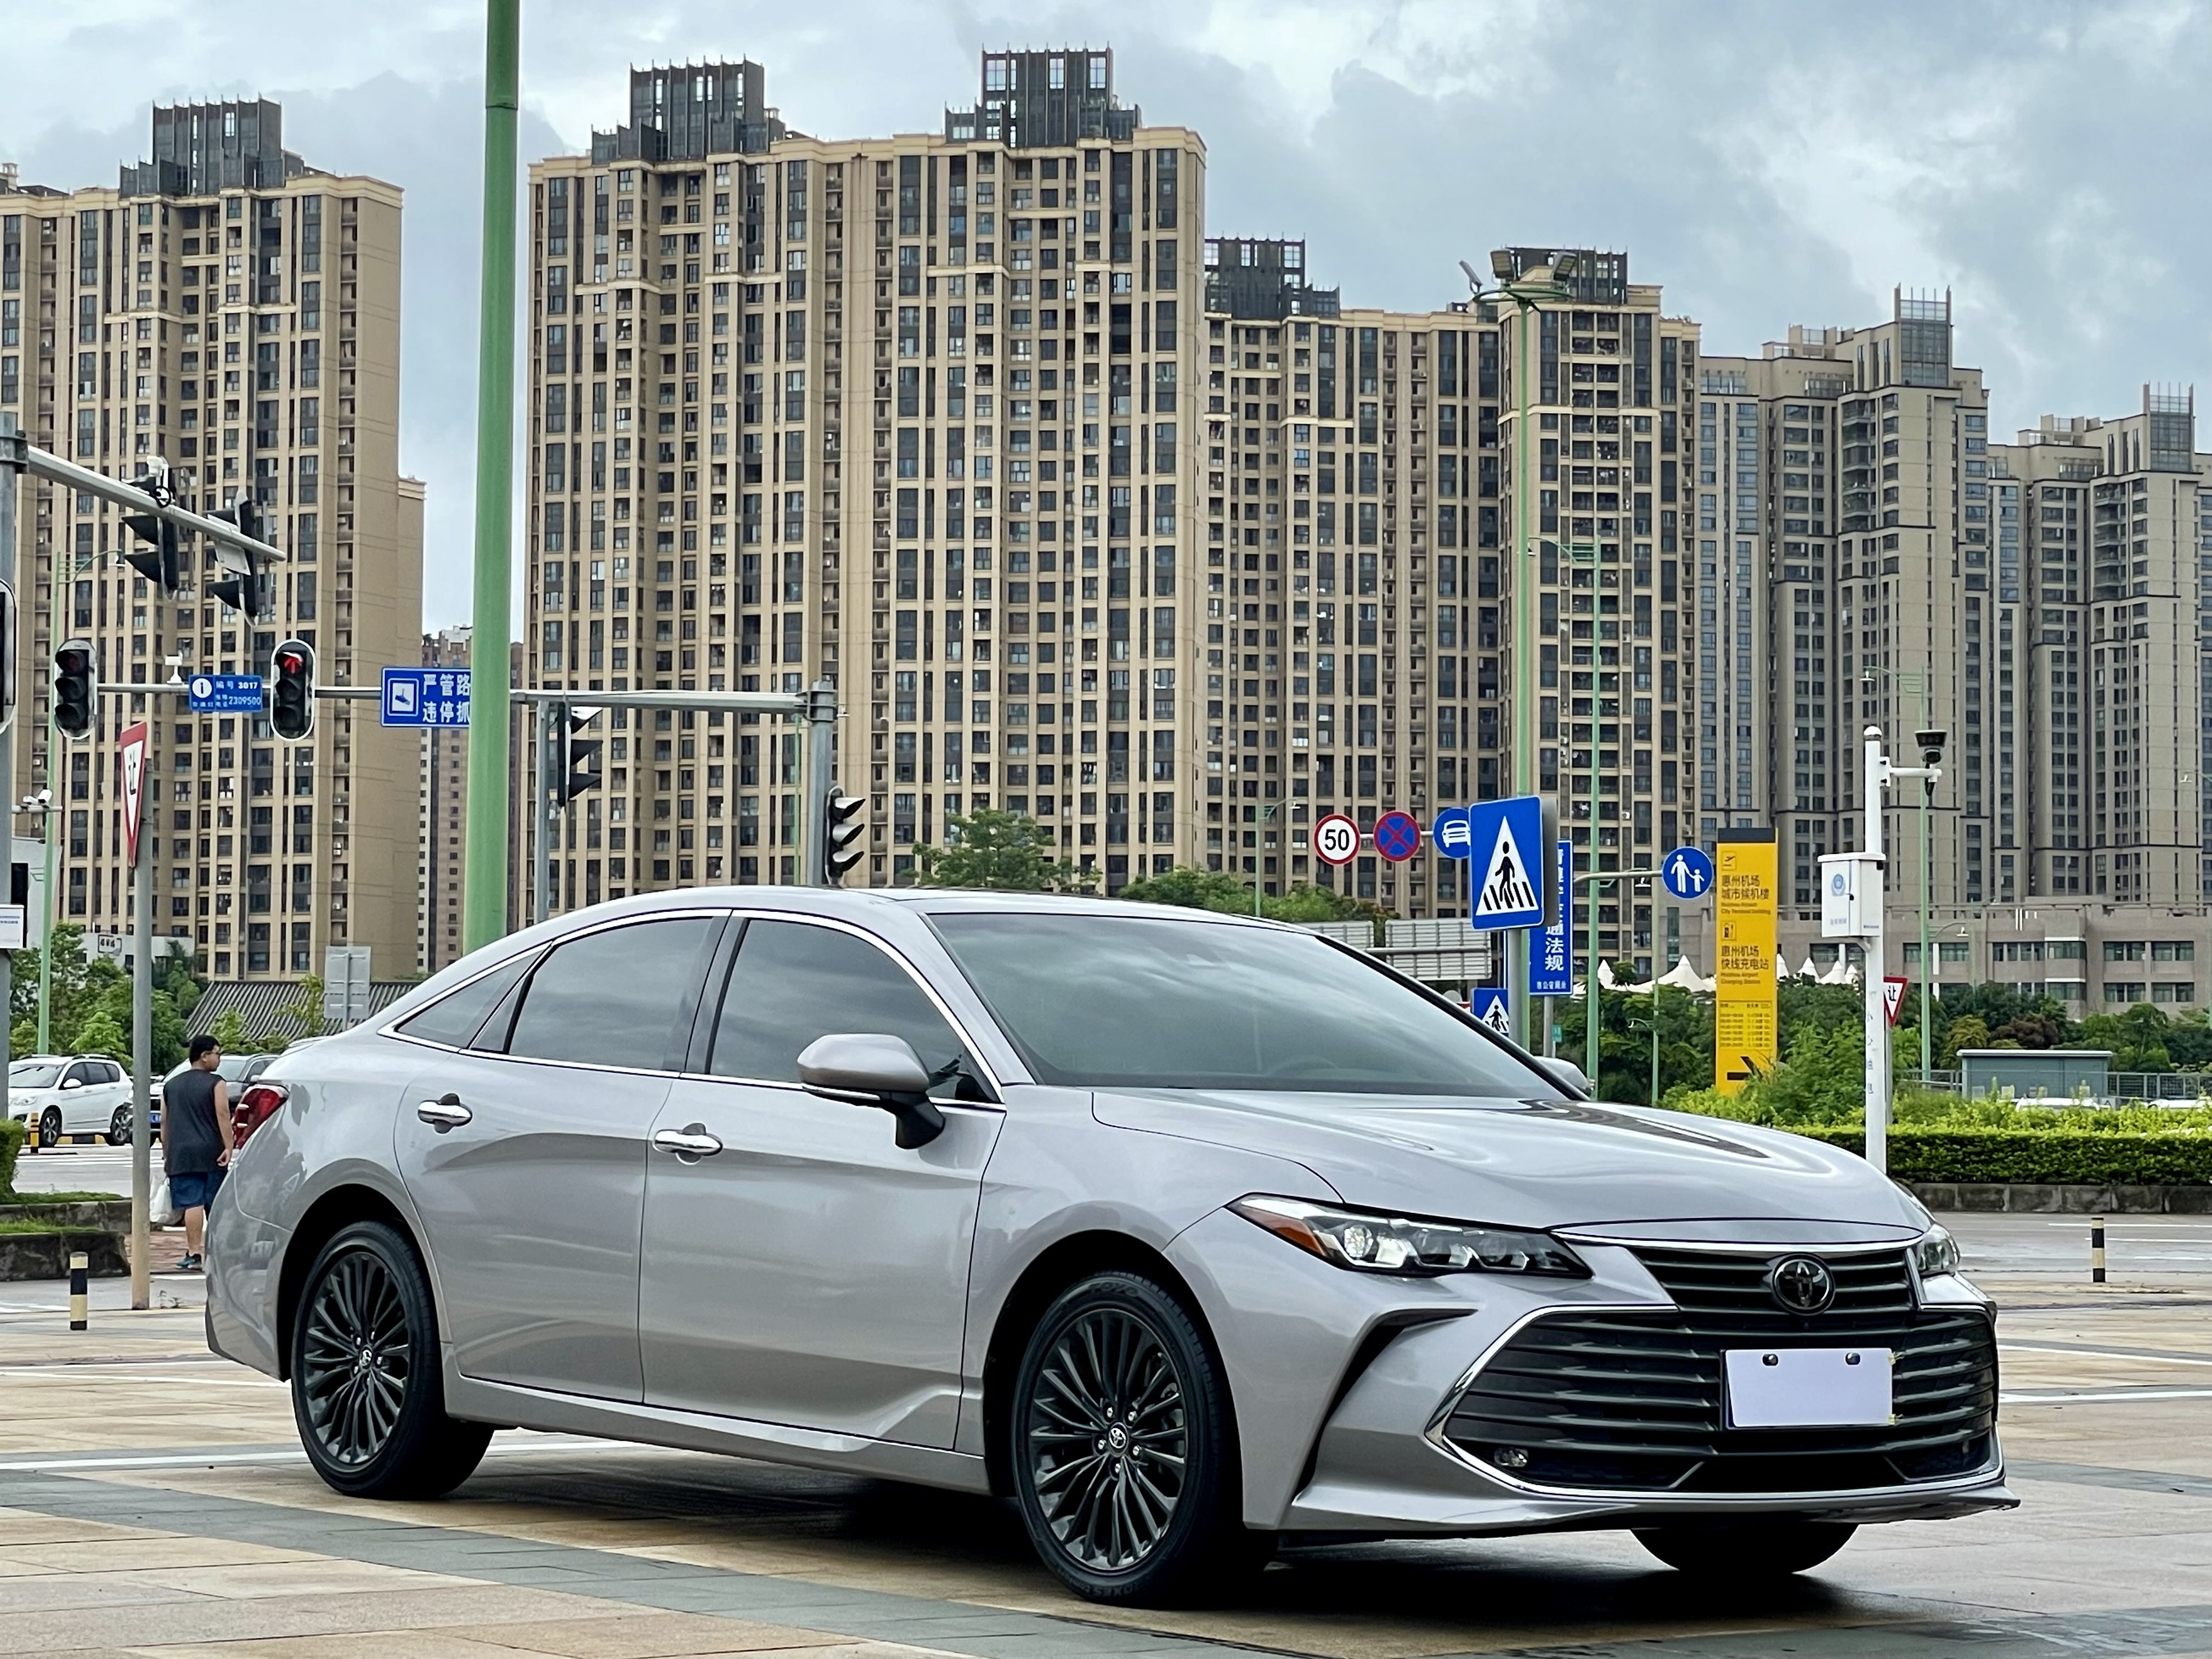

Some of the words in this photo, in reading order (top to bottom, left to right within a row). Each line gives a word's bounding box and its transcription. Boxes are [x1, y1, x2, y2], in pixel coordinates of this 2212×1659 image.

[238, 681, 258, 690] 3017
[423, 674, 471, 696] 严管路
[228, 696, 261, 706] 2309500
[422, 701, 471, 723] 违停抓
[1325, 829, 1350, 851] 50
[1722, 874, 1760, 887] 惠州机场
[1721, 946, 1759, 957] 惠州机场
[1722, 958, 1769, 970] 快线充电站
[1888, 985, 1897, 1002] 让
